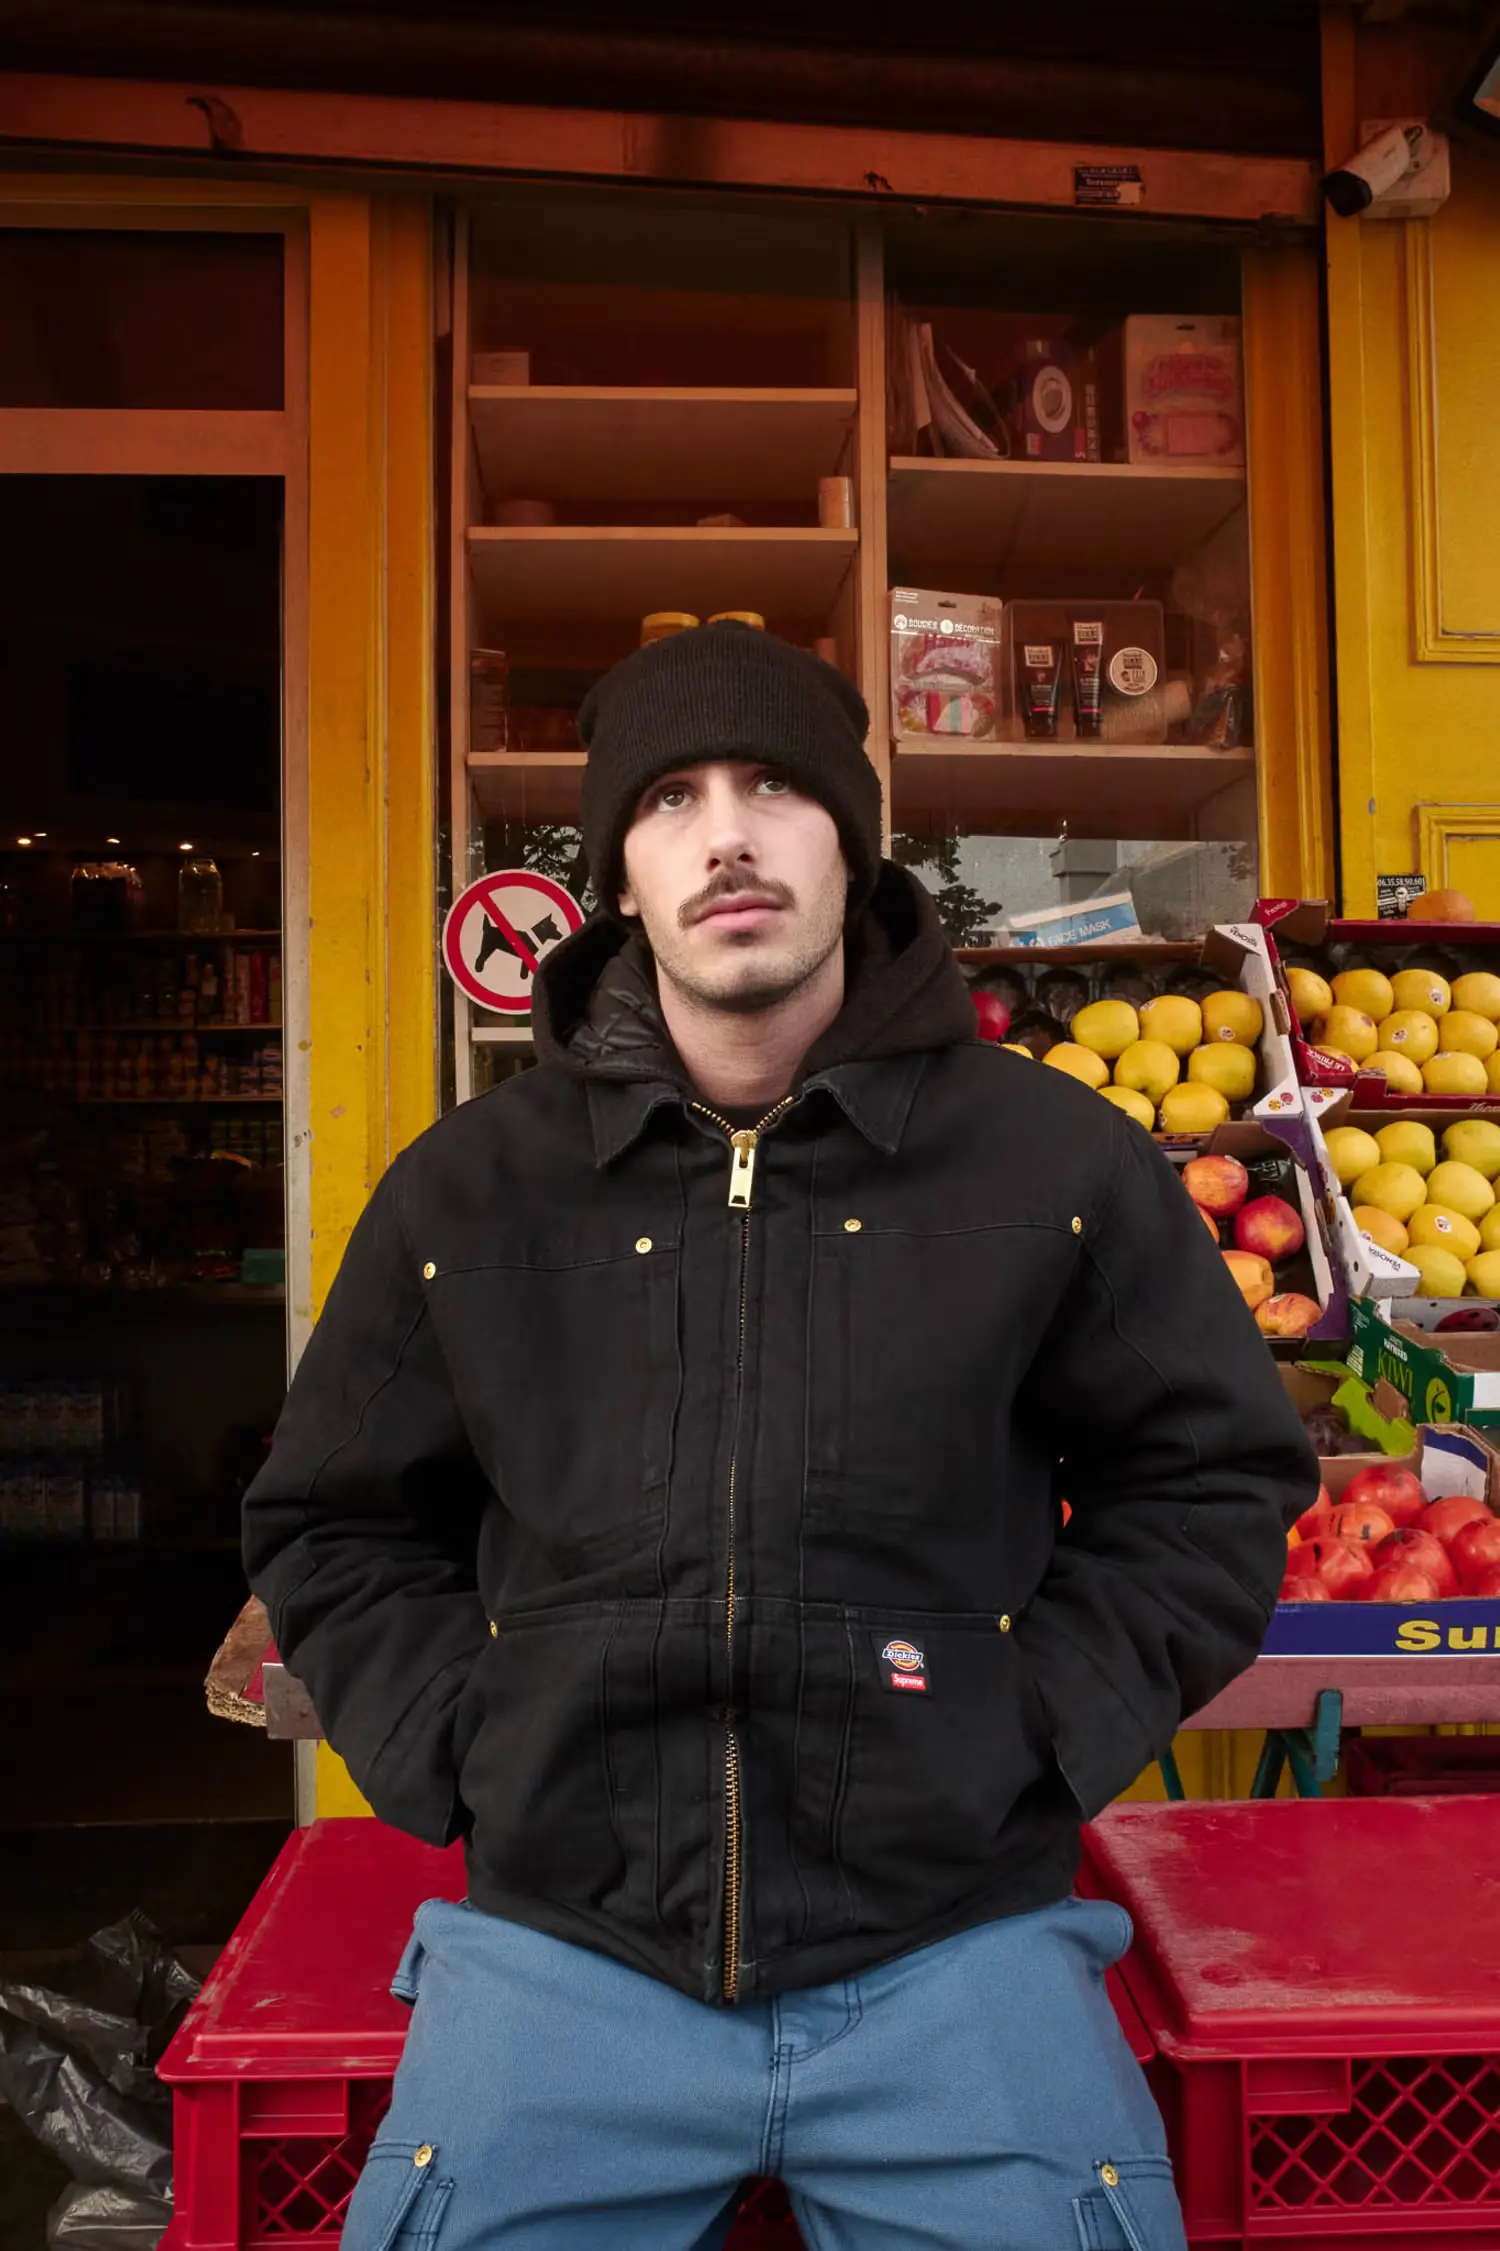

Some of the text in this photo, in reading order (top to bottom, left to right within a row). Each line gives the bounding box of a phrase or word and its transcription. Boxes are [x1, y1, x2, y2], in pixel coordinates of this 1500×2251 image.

[1080, 918, 1112, 937] MASK
[1395, 1619, 1500, 1652] Su
[887, 1650, 920, 1661] Dickies
[893, 1673, 923, 1687] Supreme
